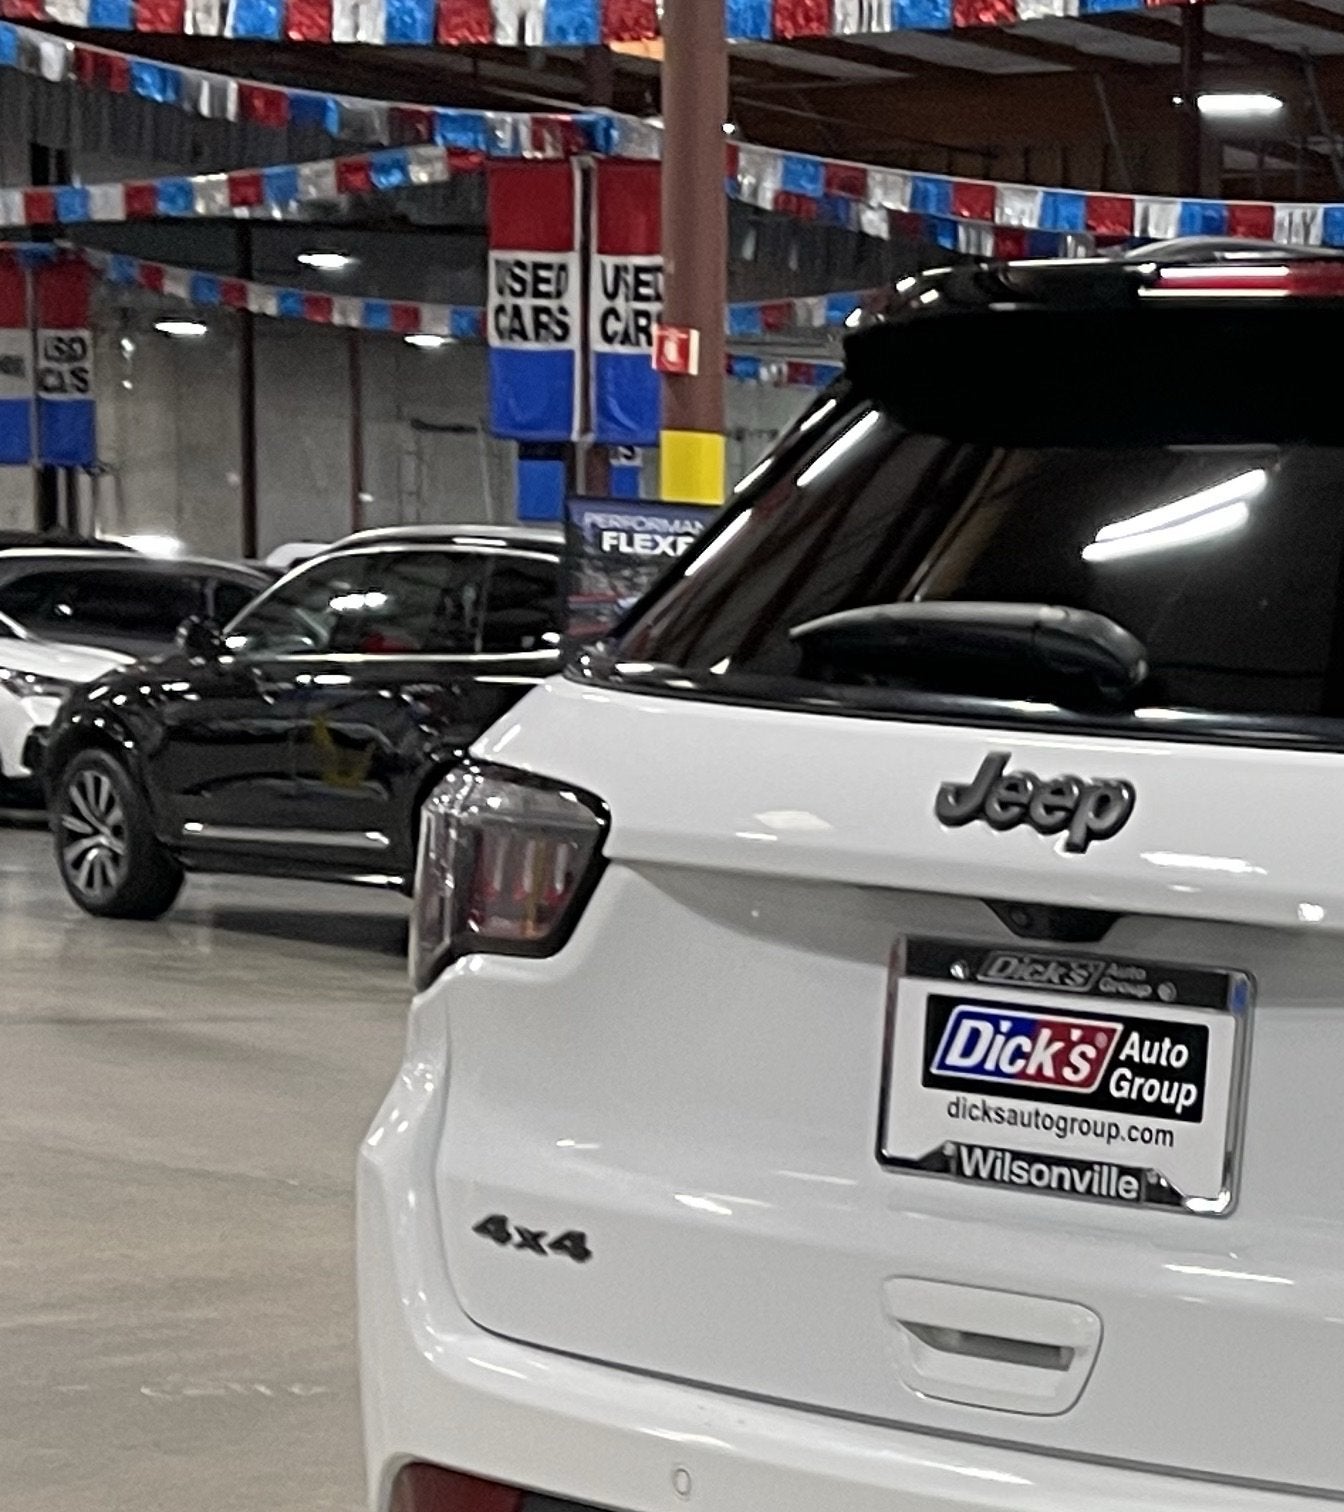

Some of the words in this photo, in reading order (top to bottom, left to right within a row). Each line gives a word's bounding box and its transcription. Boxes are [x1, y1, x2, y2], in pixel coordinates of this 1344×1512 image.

[935, 751, 1136, 854] Jeep
[944, 1017, 1097, 1083] Dick's
[1119, 1031, 1190, 1068] Auto
[1108, 1067, 1198, 1114] Group
[947, 1097, 1175, 1147] dicksautogroup.com
[959, 1145, 1140, 1199] Wilsonville
